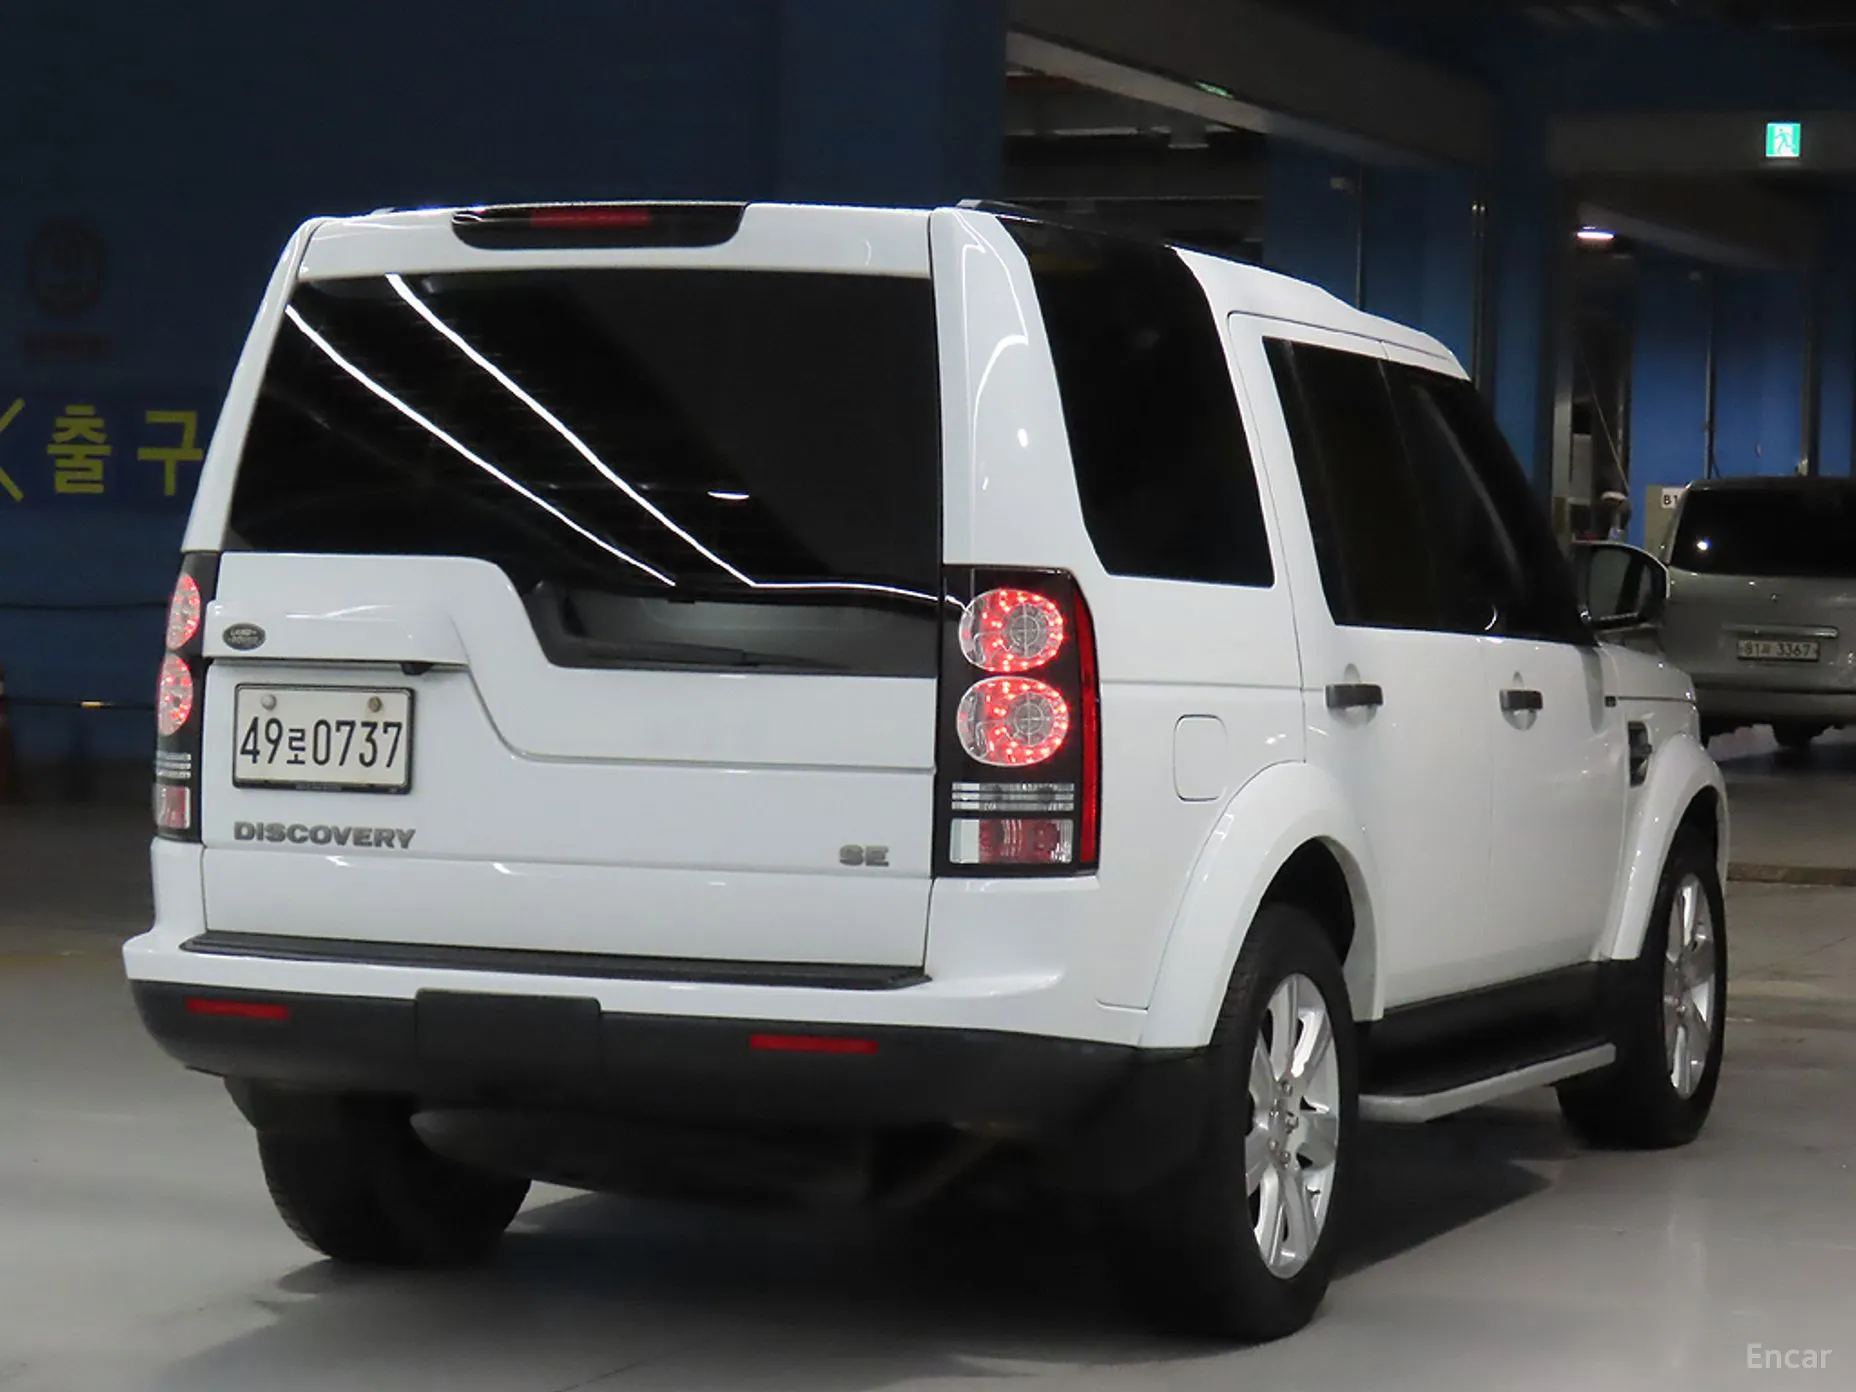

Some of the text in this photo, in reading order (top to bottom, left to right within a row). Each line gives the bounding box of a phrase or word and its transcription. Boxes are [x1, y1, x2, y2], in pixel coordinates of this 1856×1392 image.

[47, 404, 204, 496] 출구
[240, 716, 402, 768] 49로0737
[234, 822, 416, 849] DISCOVERY
[839, 844, 889, 867] SE
